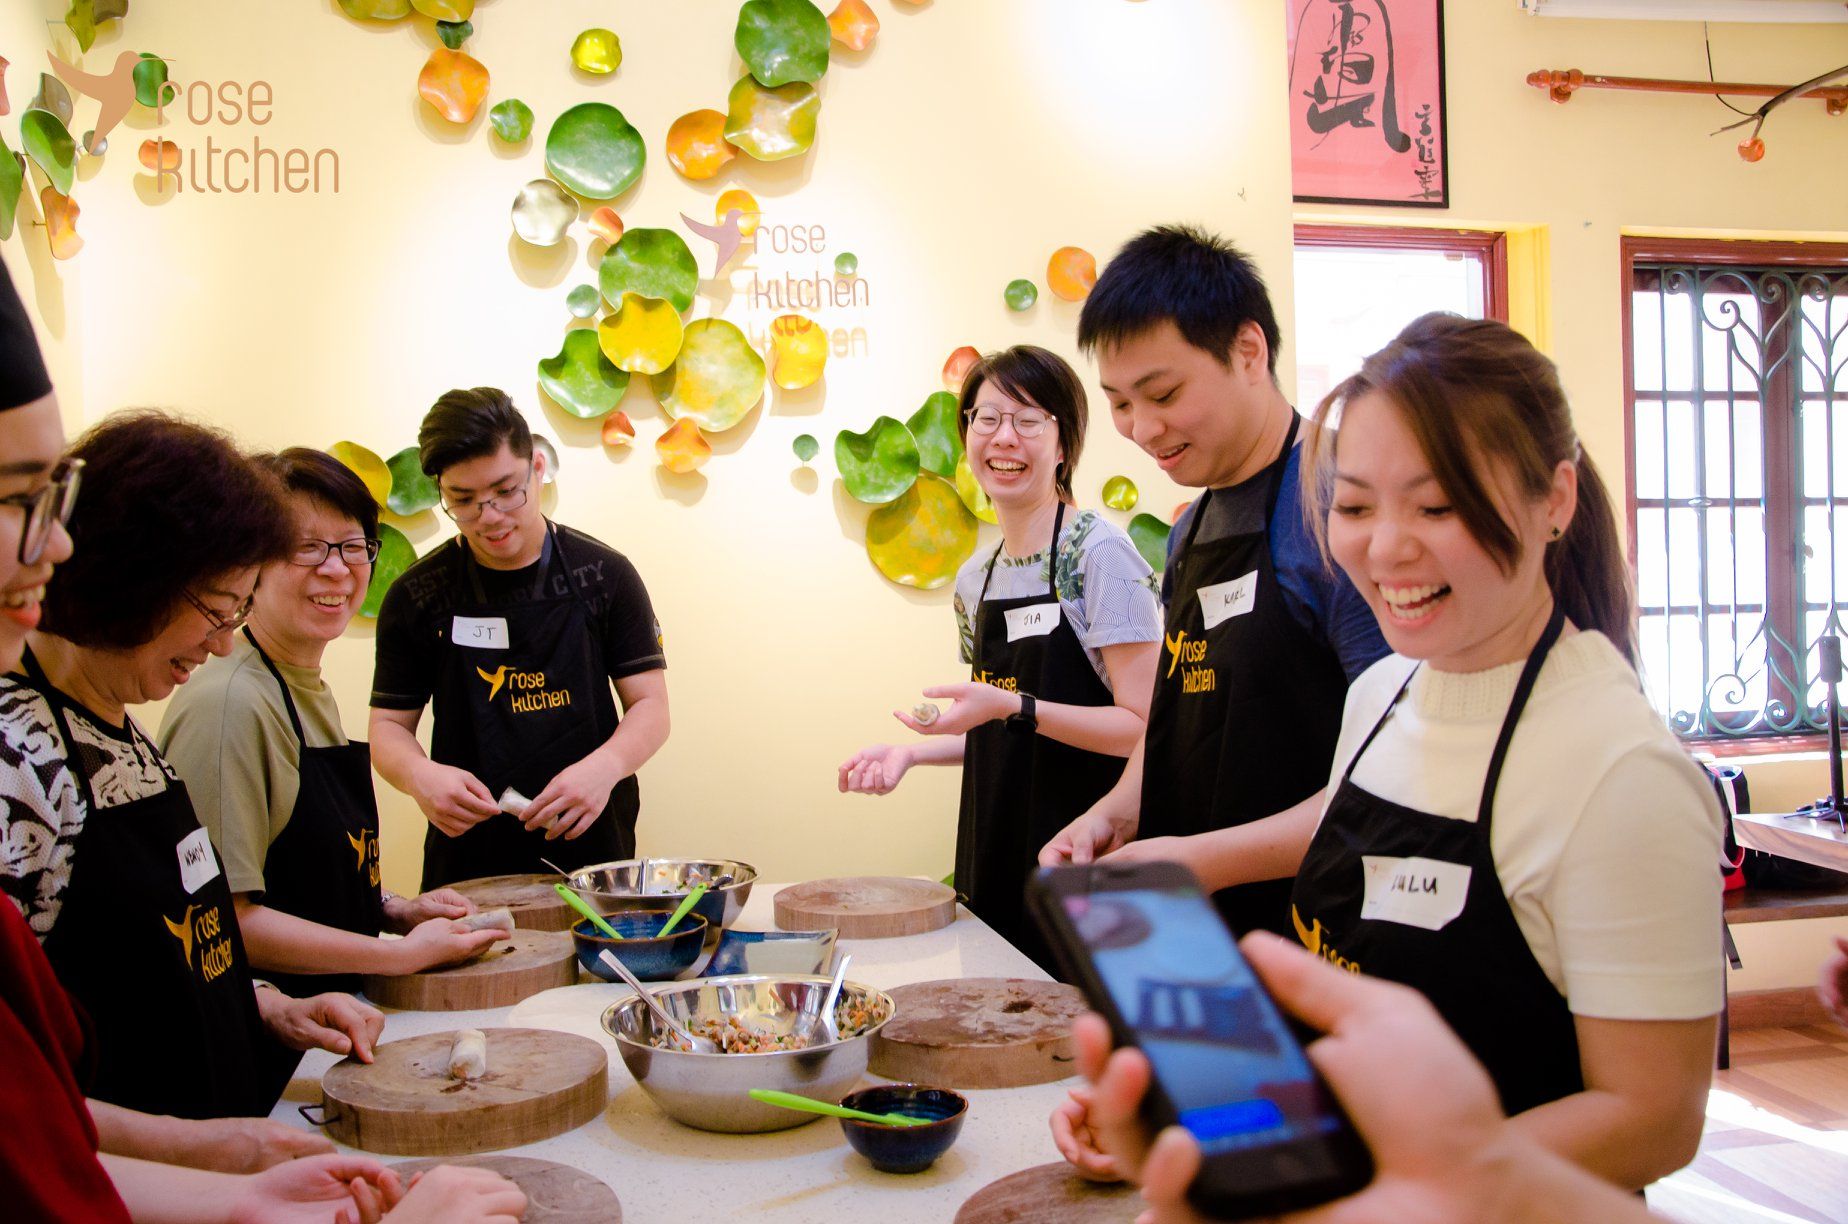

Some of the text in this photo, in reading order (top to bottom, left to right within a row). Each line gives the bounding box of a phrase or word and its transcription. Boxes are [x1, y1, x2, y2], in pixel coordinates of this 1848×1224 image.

[753, 224, 826, 254] rose
[754, 270, 869, 309] kitchen
[552, 560, 604, 596] CTY
[472, 624, 497, 641] JT
[1022, 611, 1042, 627] JIA
[1180, 639, 1208, 664] rose
[509, 671, 545, 690] rose
[1182, 666, 1216, 694] kitchen
[510, 688, 571, 714] kitchen
[195, 906, 221, 944] rose
